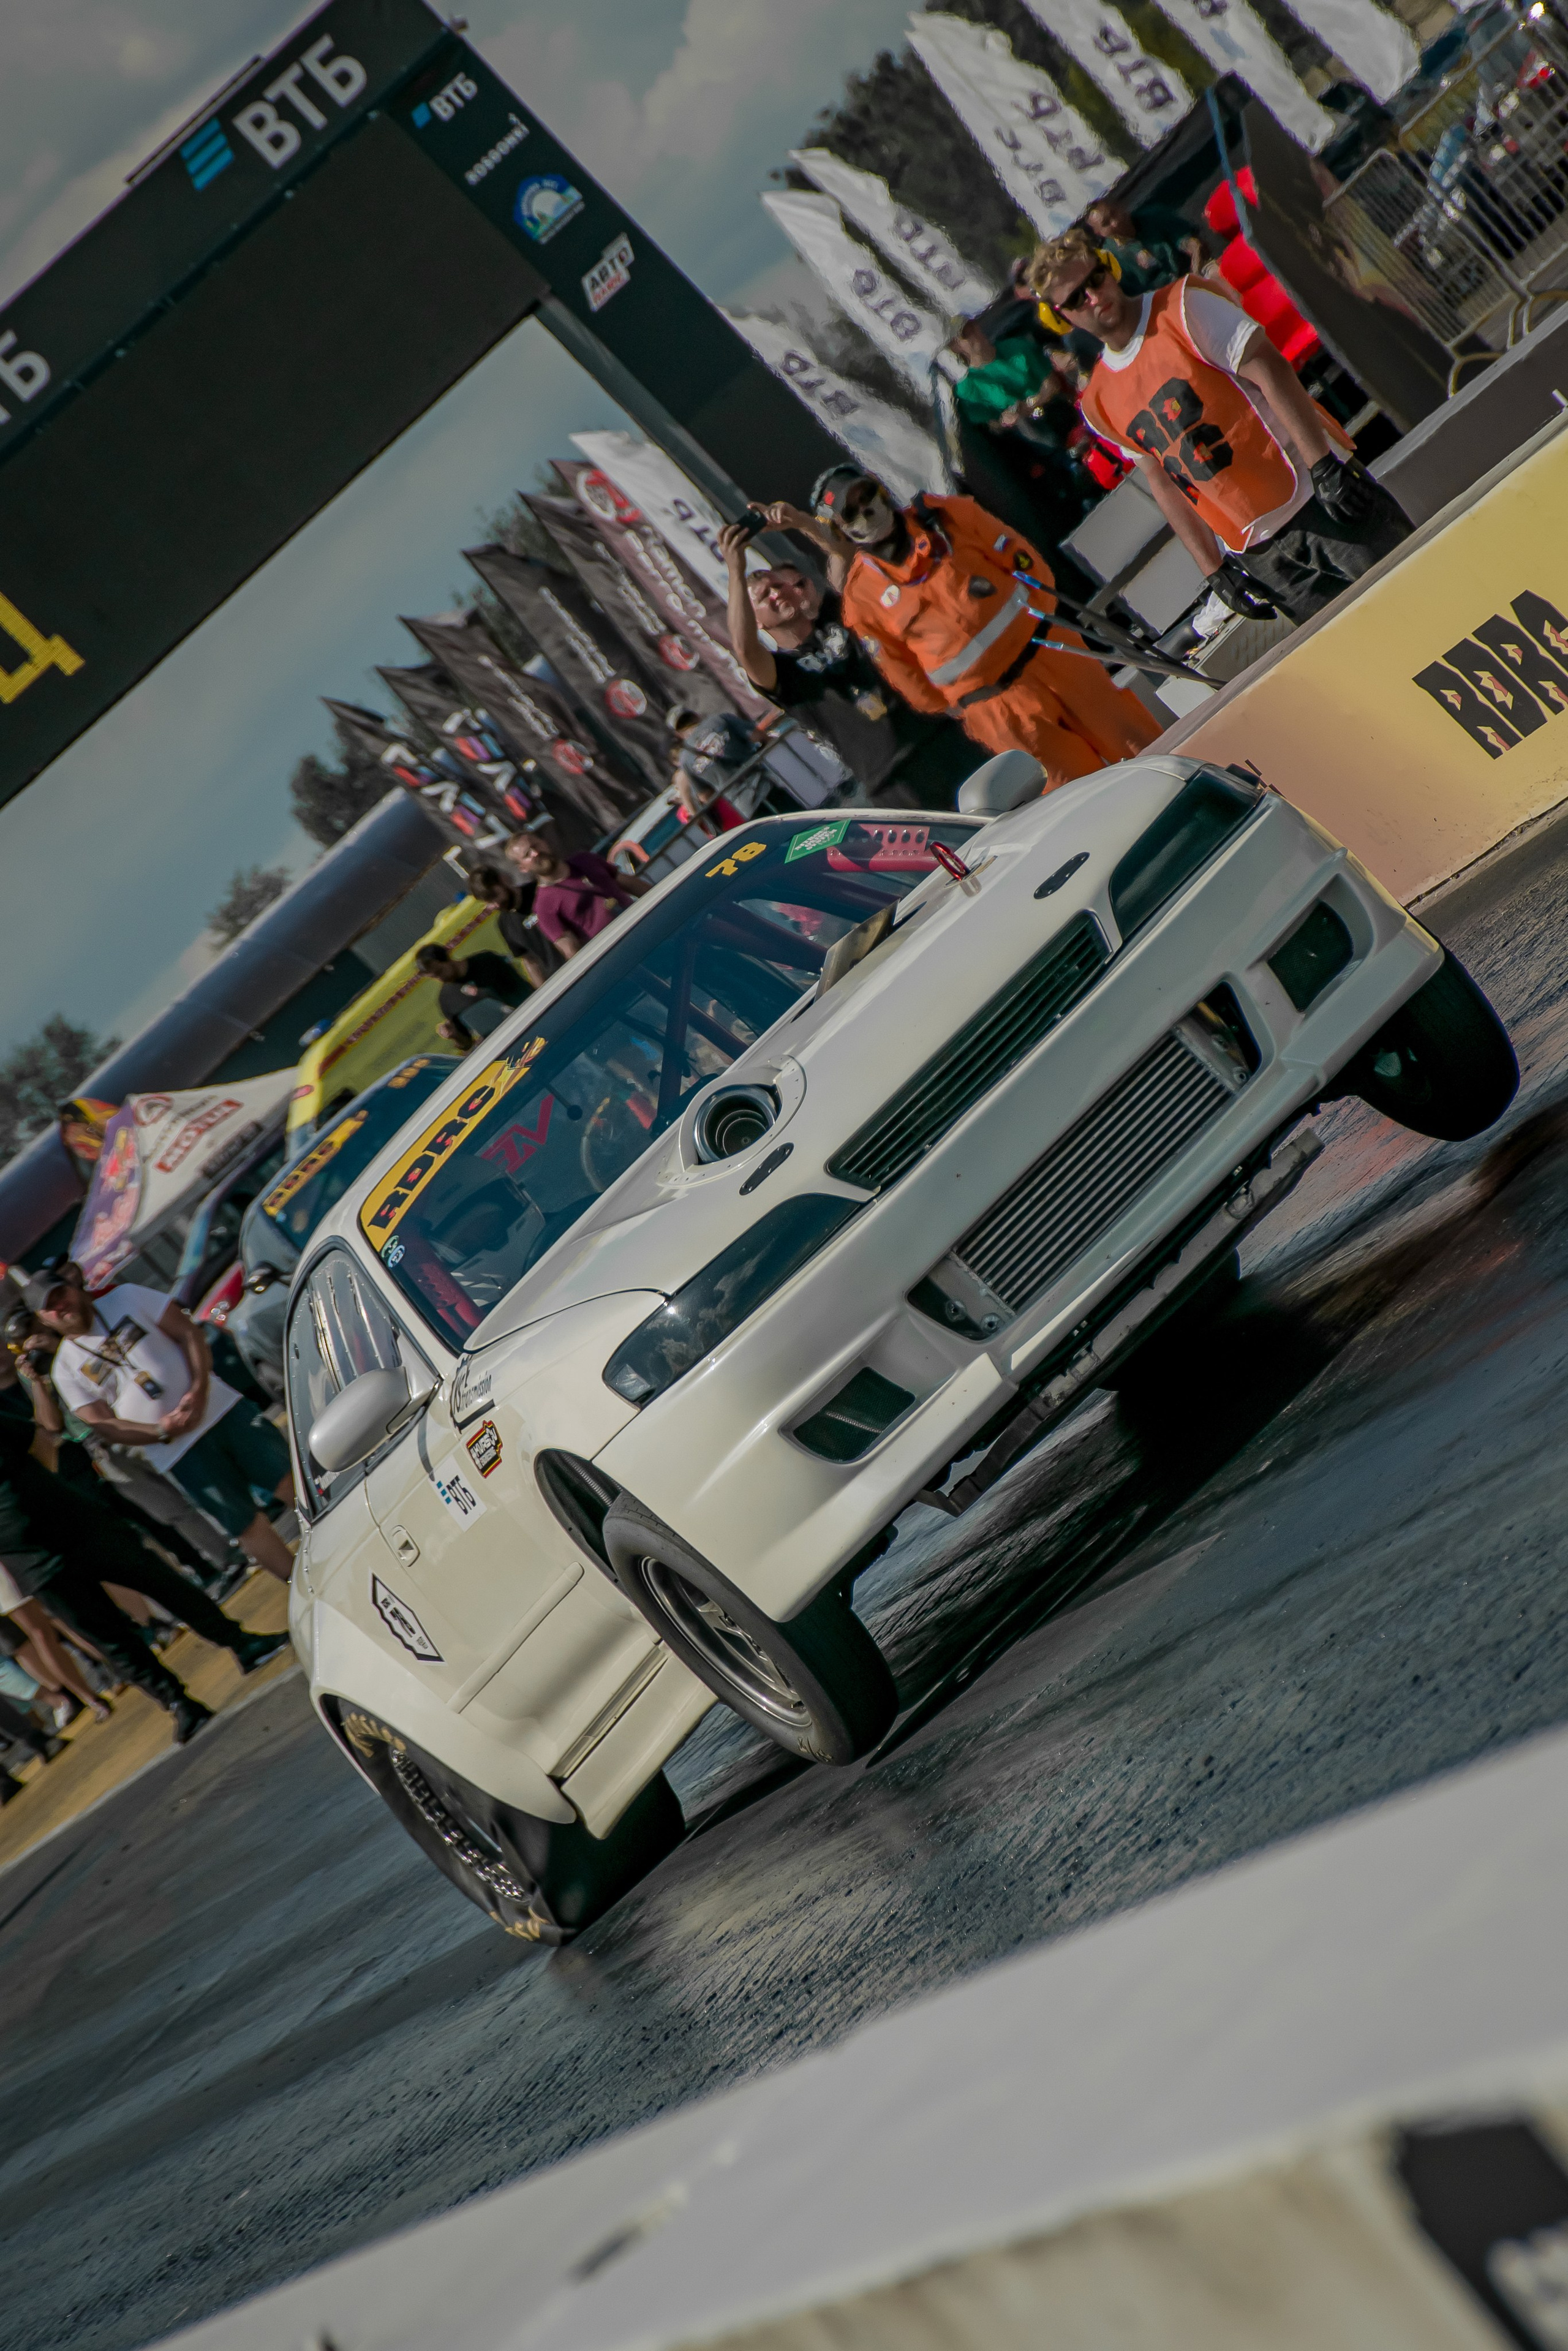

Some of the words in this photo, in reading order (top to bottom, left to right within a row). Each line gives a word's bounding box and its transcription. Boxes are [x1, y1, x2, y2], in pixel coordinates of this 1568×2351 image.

[232, 33, 369, 170] ВТБ
[429, 71, 478, 122] ВТБ
[1092, 24, 1177, 111] ВТБ
[706, 842, 766, 877] 78
[367, 1084, 496, 1229] RDRC
[446, 1474, 477, 1515] ВТБ
